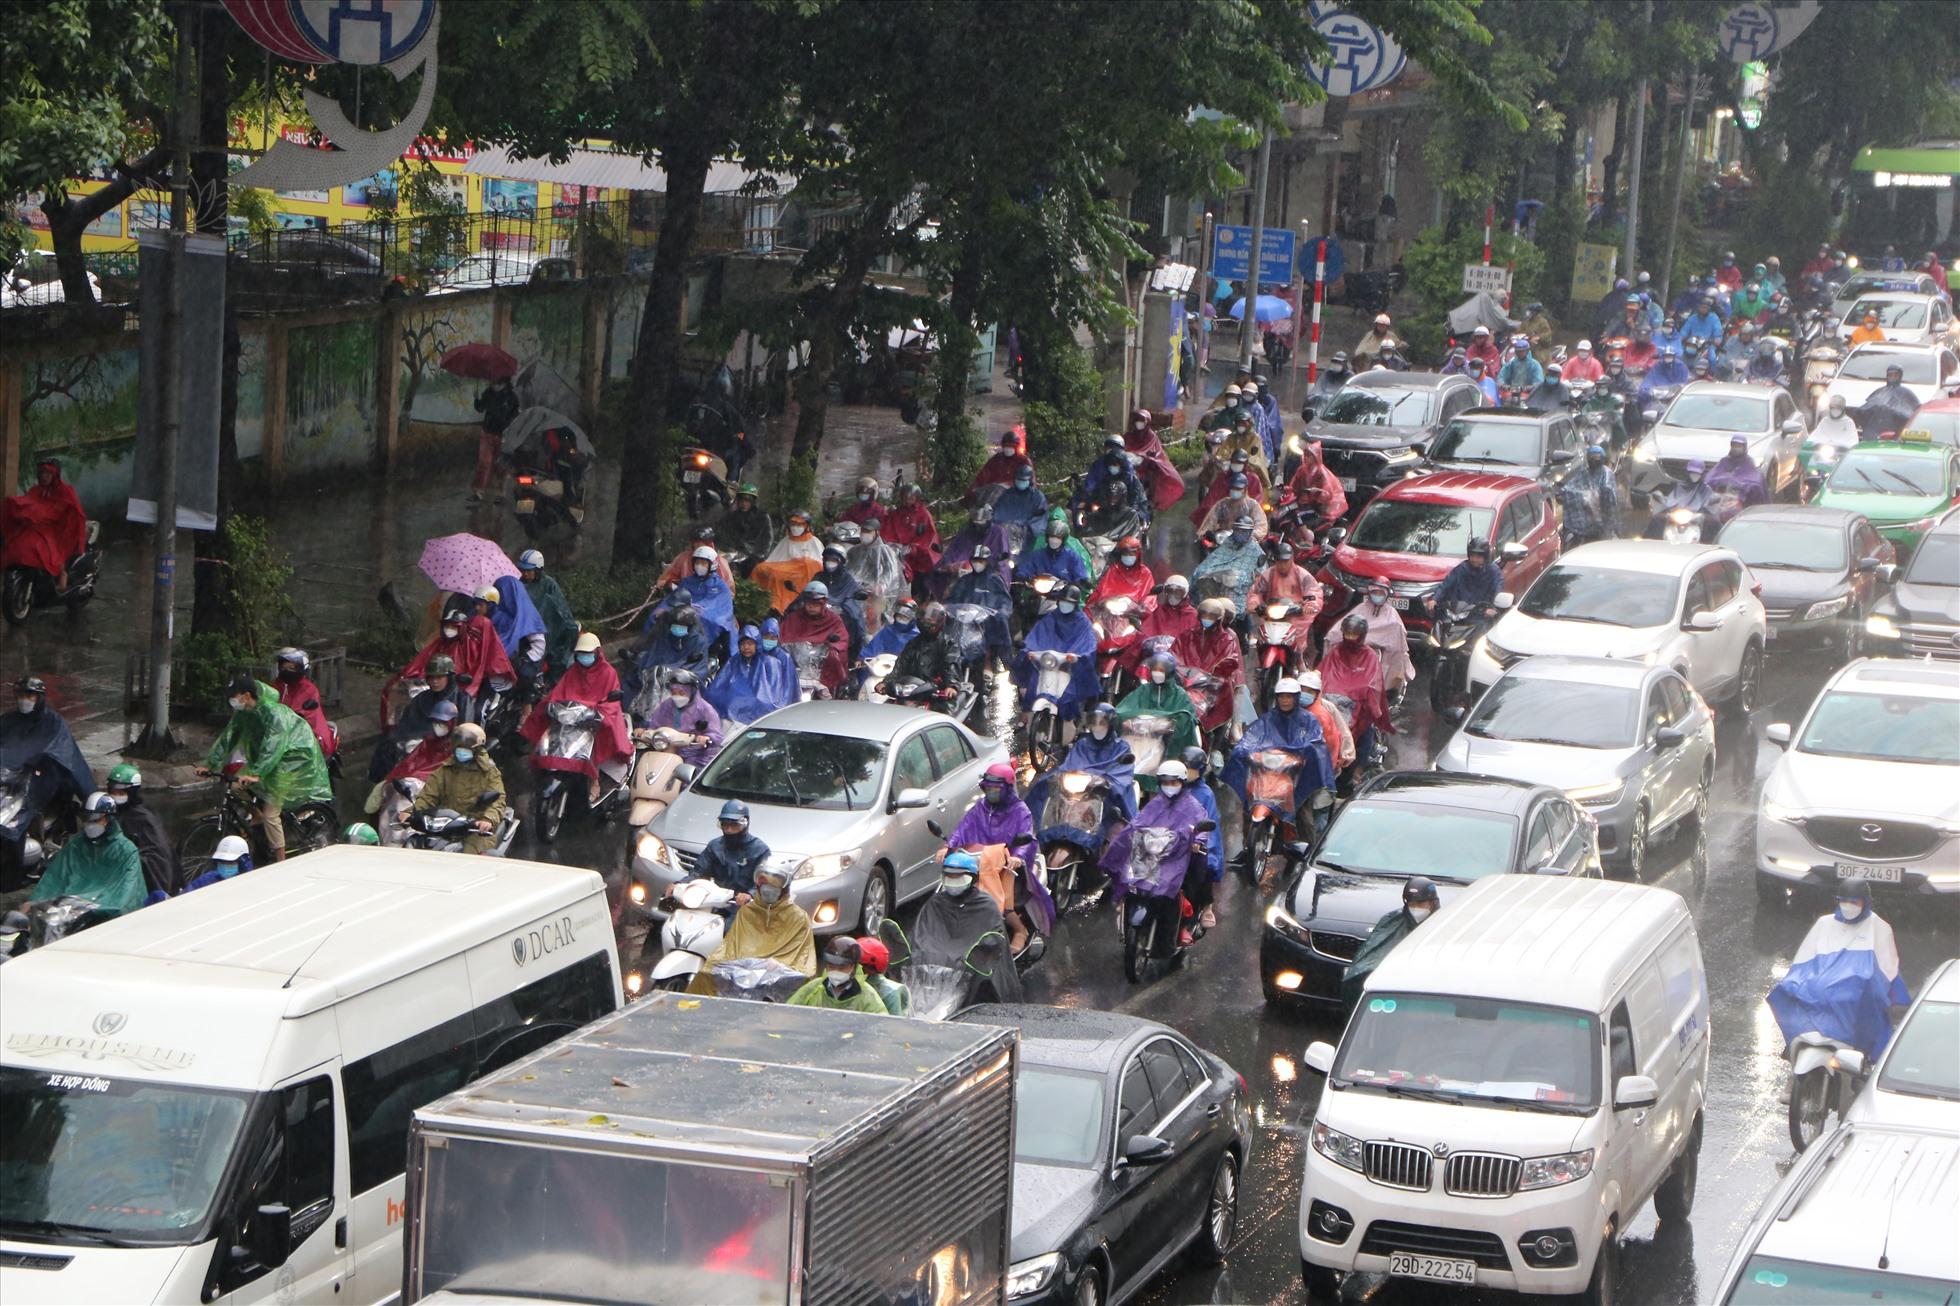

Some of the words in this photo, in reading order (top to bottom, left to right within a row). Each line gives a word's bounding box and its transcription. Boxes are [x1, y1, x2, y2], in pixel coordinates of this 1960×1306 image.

[1839, 864, 1899, 881] 30F-244.91
[528, 916, 576, 961] DCAR
[47, 1074, 61, 1087] XE
[1391, 1256, 1473, 1281] 29D-222.54
